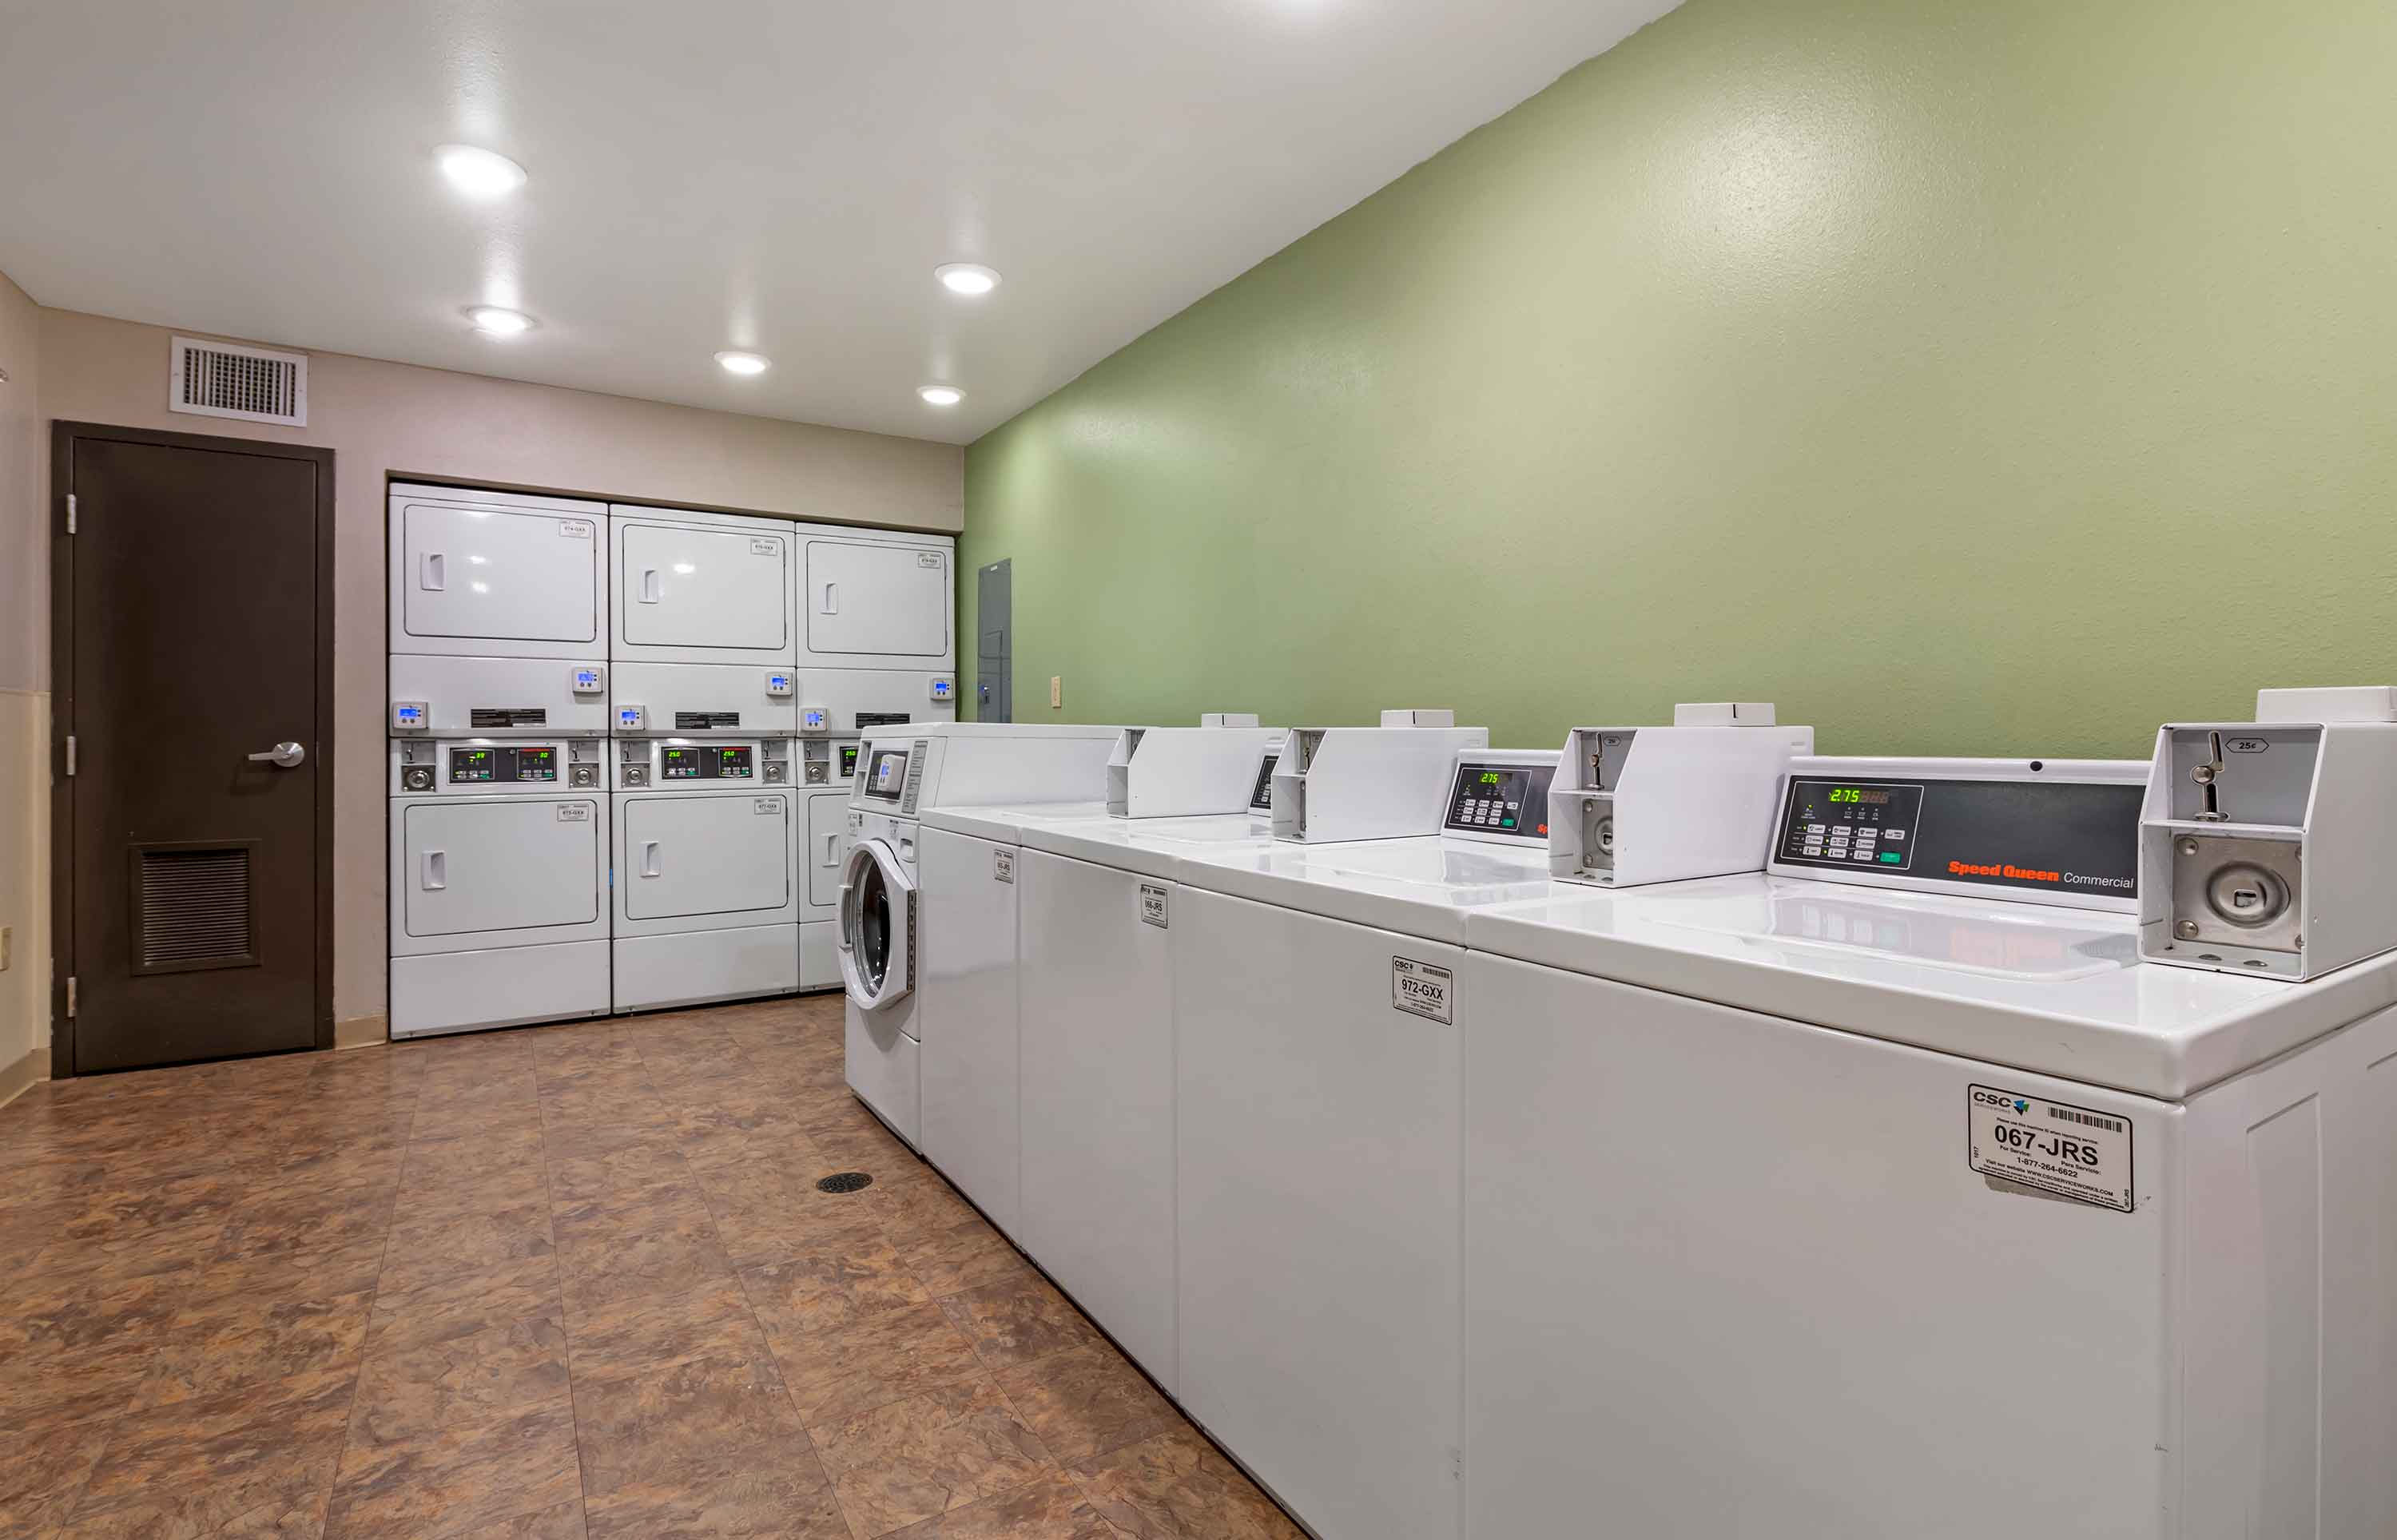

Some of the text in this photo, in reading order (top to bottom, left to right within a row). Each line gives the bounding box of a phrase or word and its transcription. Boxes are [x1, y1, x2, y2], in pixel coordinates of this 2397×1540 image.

[1831, 790, 1860, 803] 2.75
[1948, 861, 2135, 889] Speed Queen Commercial
[1395, 960, 1409, 969] CSC
[1401, 978, 1443, 1001] 972-GXX
[1973, 1091, 2012, 1108] CSC
[1995, 1125, 2098, 1166] 067-JRS
[2017, 1156, 2077, 1178] 1-877-264-6622
